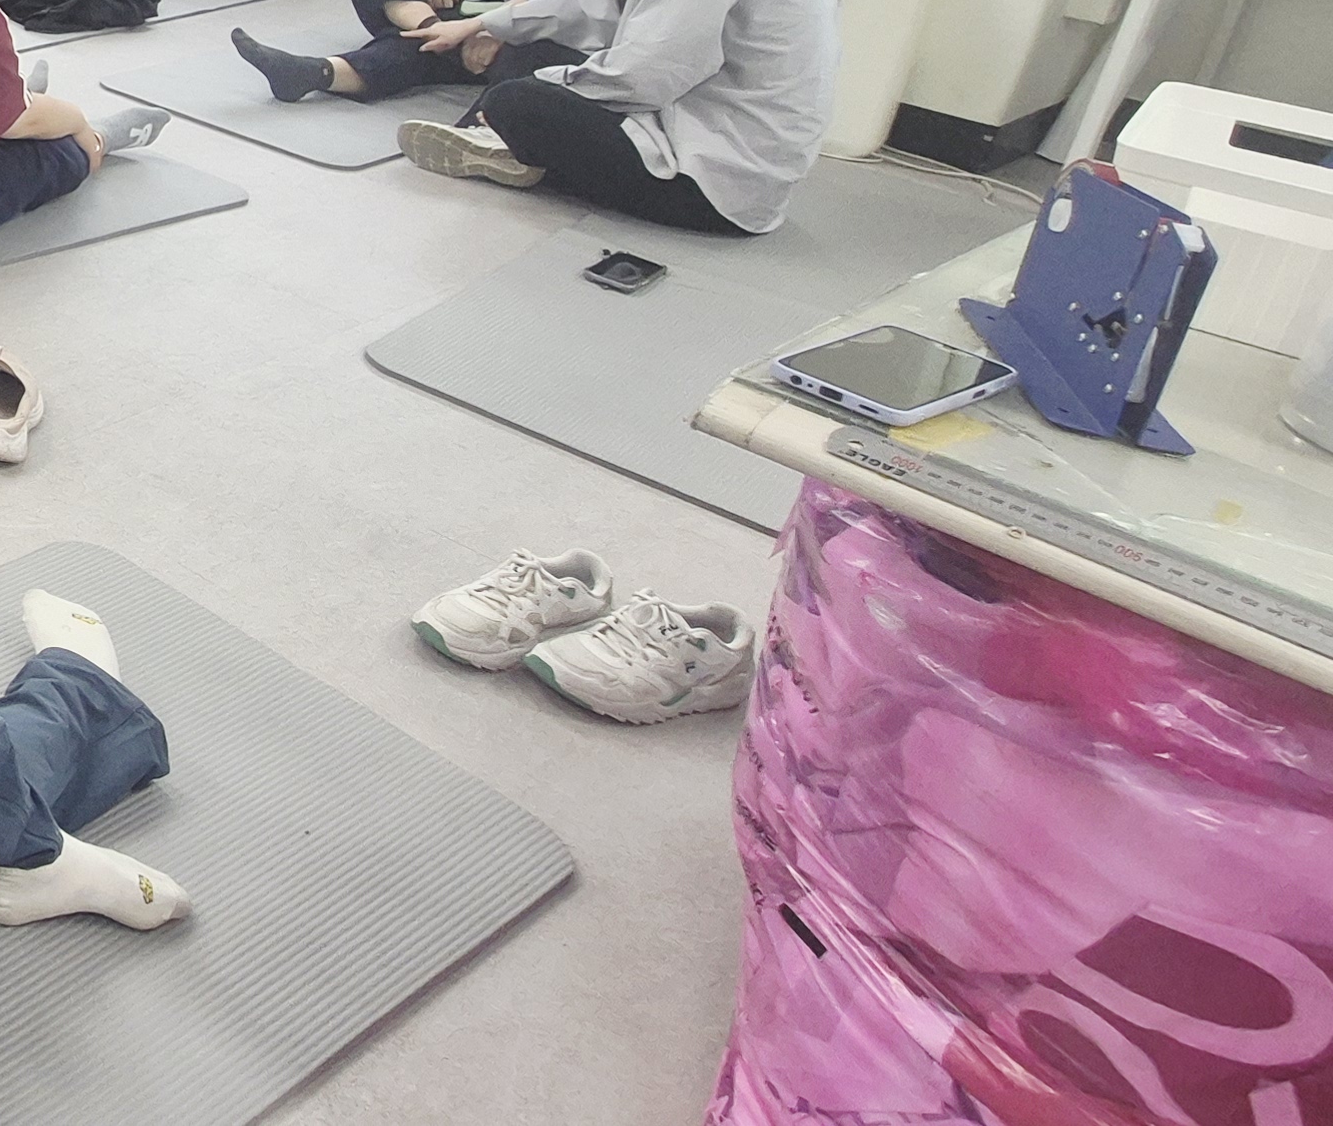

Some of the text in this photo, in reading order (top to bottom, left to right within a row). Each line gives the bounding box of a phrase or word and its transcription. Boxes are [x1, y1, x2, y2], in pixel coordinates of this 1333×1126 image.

[844, 448, 908, 477] EAGLE
[890, 455, 923, 473] 1000
[1113, 544, 1144, 562] 900
